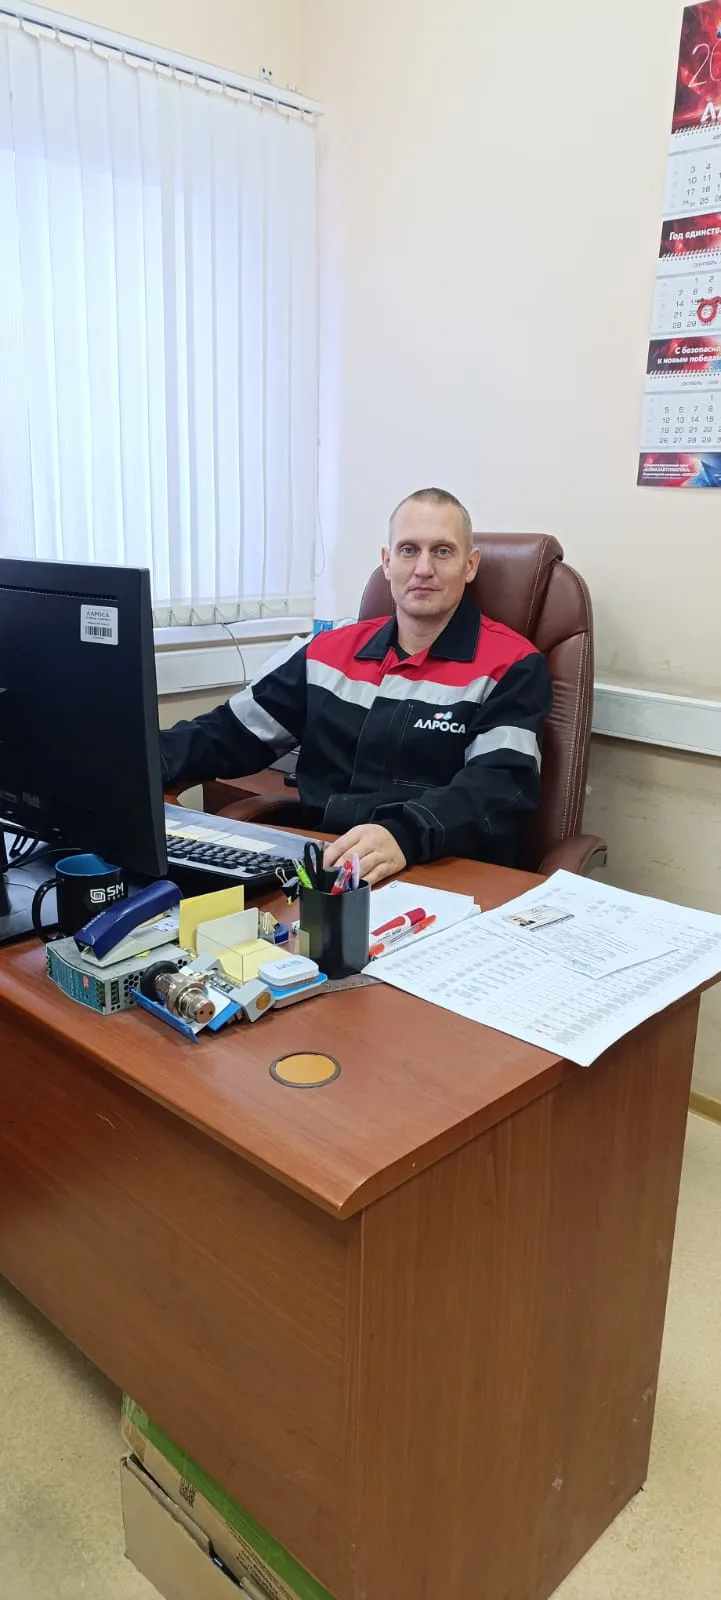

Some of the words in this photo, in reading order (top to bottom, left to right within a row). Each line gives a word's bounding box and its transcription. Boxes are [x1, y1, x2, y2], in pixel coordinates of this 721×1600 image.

[688, 176, 697, 184] 10
[687, 188, 695, 196] 17
[669, 232, 683, 240] Год
[685, 227, 721, 239] единств
[675, 299, 684, 308] 14
[672, 321, 682, 329] 28
[686, 320, 697, 328] 29
[675, 346, 681, 354] С
[674, 426, 684, 434] 20
[413, 718, 466, 734] АЛРОСА
[106, 881, 124, 897] SM
